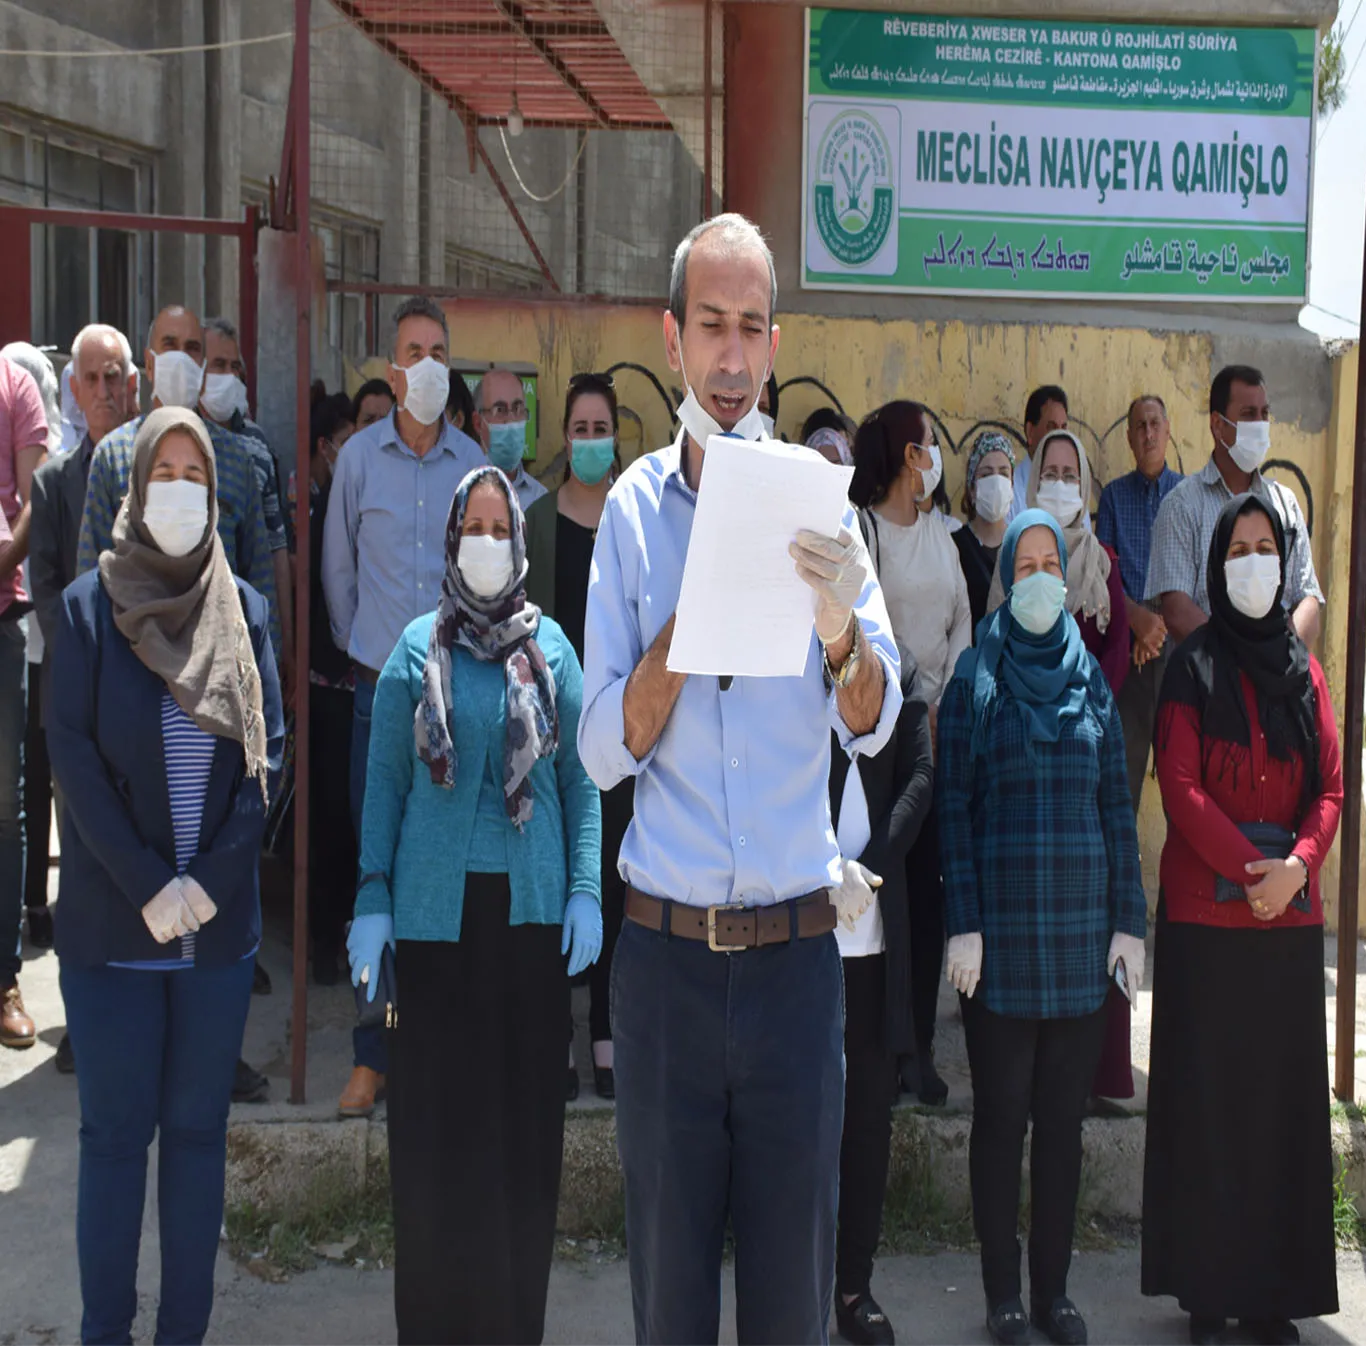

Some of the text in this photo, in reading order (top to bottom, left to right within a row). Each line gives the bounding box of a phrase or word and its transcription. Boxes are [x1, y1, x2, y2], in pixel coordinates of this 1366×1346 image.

[884, 17, 968, 40] RÊVEBERİYA
[972, 25, 1027, 43] XWESER
[1030, 29, 1048, 44] YA
[1052, 29, 1098, 47] BAKUR
[1102, 28, 1111, 47] Û
[1115, 29, 1185, 50] ROJHİLATİ
[936, 44, 991, 63] HERÊMA
[995, 47, 1042, 66] CEZİRÊ
[1054, 51, 1118, 68] KANTONA
[1122, 53, 1182, 73] QAMİŞLO
[916, 121, 1031, 187] MECLİSA
[1040, 136, 1163, 204] NAVÇEYA
[1172, 130, 1288, 208] QAMİŞLO
[1120, 237, 1290, 283] مجلس ناحية قامشلو
